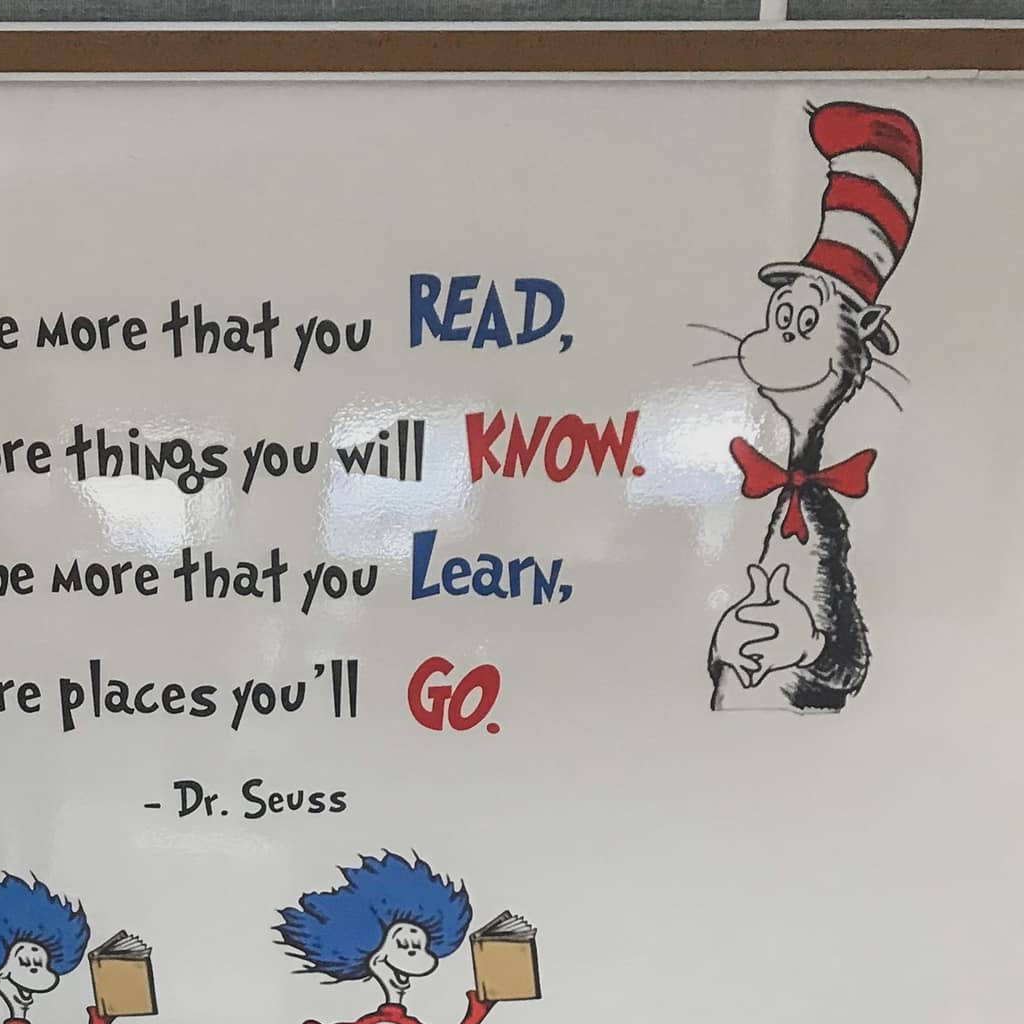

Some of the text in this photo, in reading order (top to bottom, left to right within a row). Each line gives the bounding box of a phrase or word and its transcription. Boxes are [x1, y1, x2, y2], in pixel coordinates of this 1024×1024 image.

[36, 311, 148, 352] more
[161, 299, 280, 360] that
[293, 316, 372, 372] you
[410, 274, 573, 353] READ,
[65, 423, 229, 495] things
[241, 439, 319, 494] you
[336, 418, 426, 482] will
[466, 410, 646, 483] KNOW.
[51, 559, 160, 597] more
[173, 546, 289, 603] that
[301, 562, 378, 616] you
[412, 530, 573, 606] Learn,
[59, 659, 218, 733] places
[231, 659, 360, 732] you'll
[407, 655, 502, 735] GO.
[173, 779, 228, 818] Dr.
[241, 777, 348, 820] Seuss
